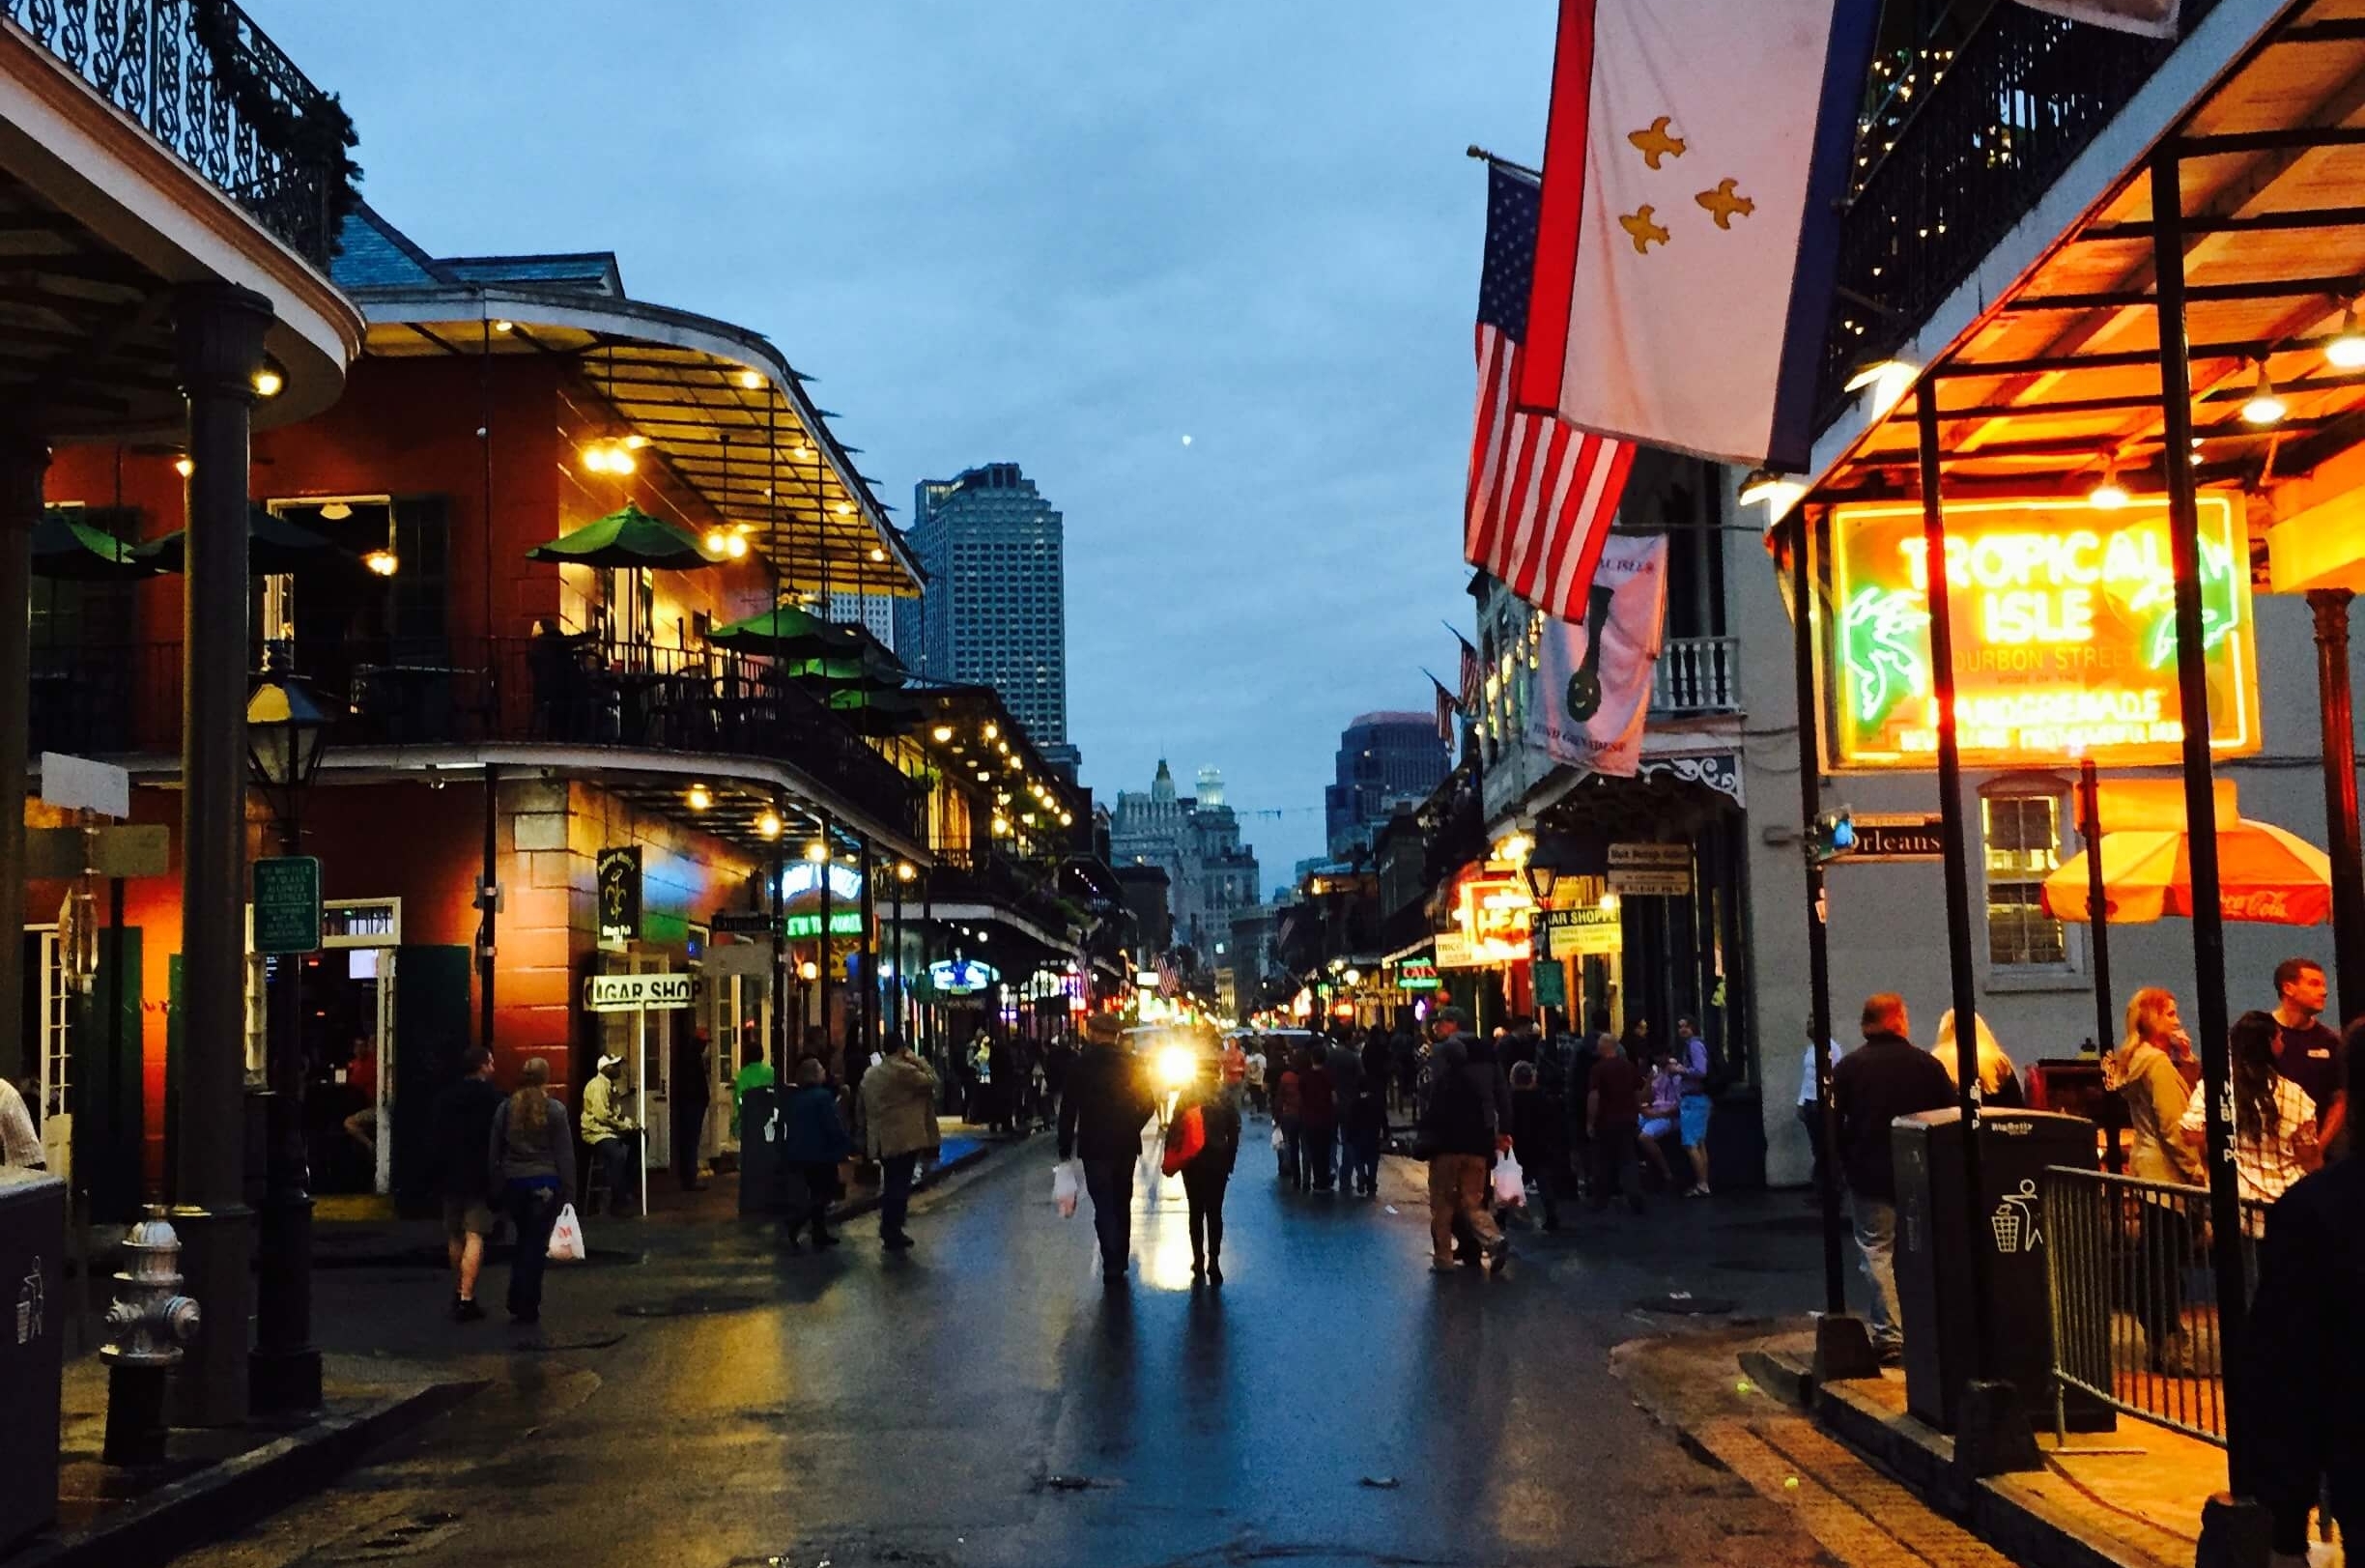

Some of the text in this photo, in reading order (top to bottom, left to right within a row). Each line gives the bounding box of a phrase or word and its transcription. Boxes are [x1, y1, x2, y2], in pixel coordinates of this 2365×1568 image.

[1899, 530, 2172, 589] TROPICAL
[1981, 586, 2096, 644] ISLE
[1952, 645, 2140, 671] OURBON STREET
[1530, 911, 1568, 928] CAR
[1570, 908, 1618, 925] SHOPPE
[650, 980, 703, 1003] SHOP
